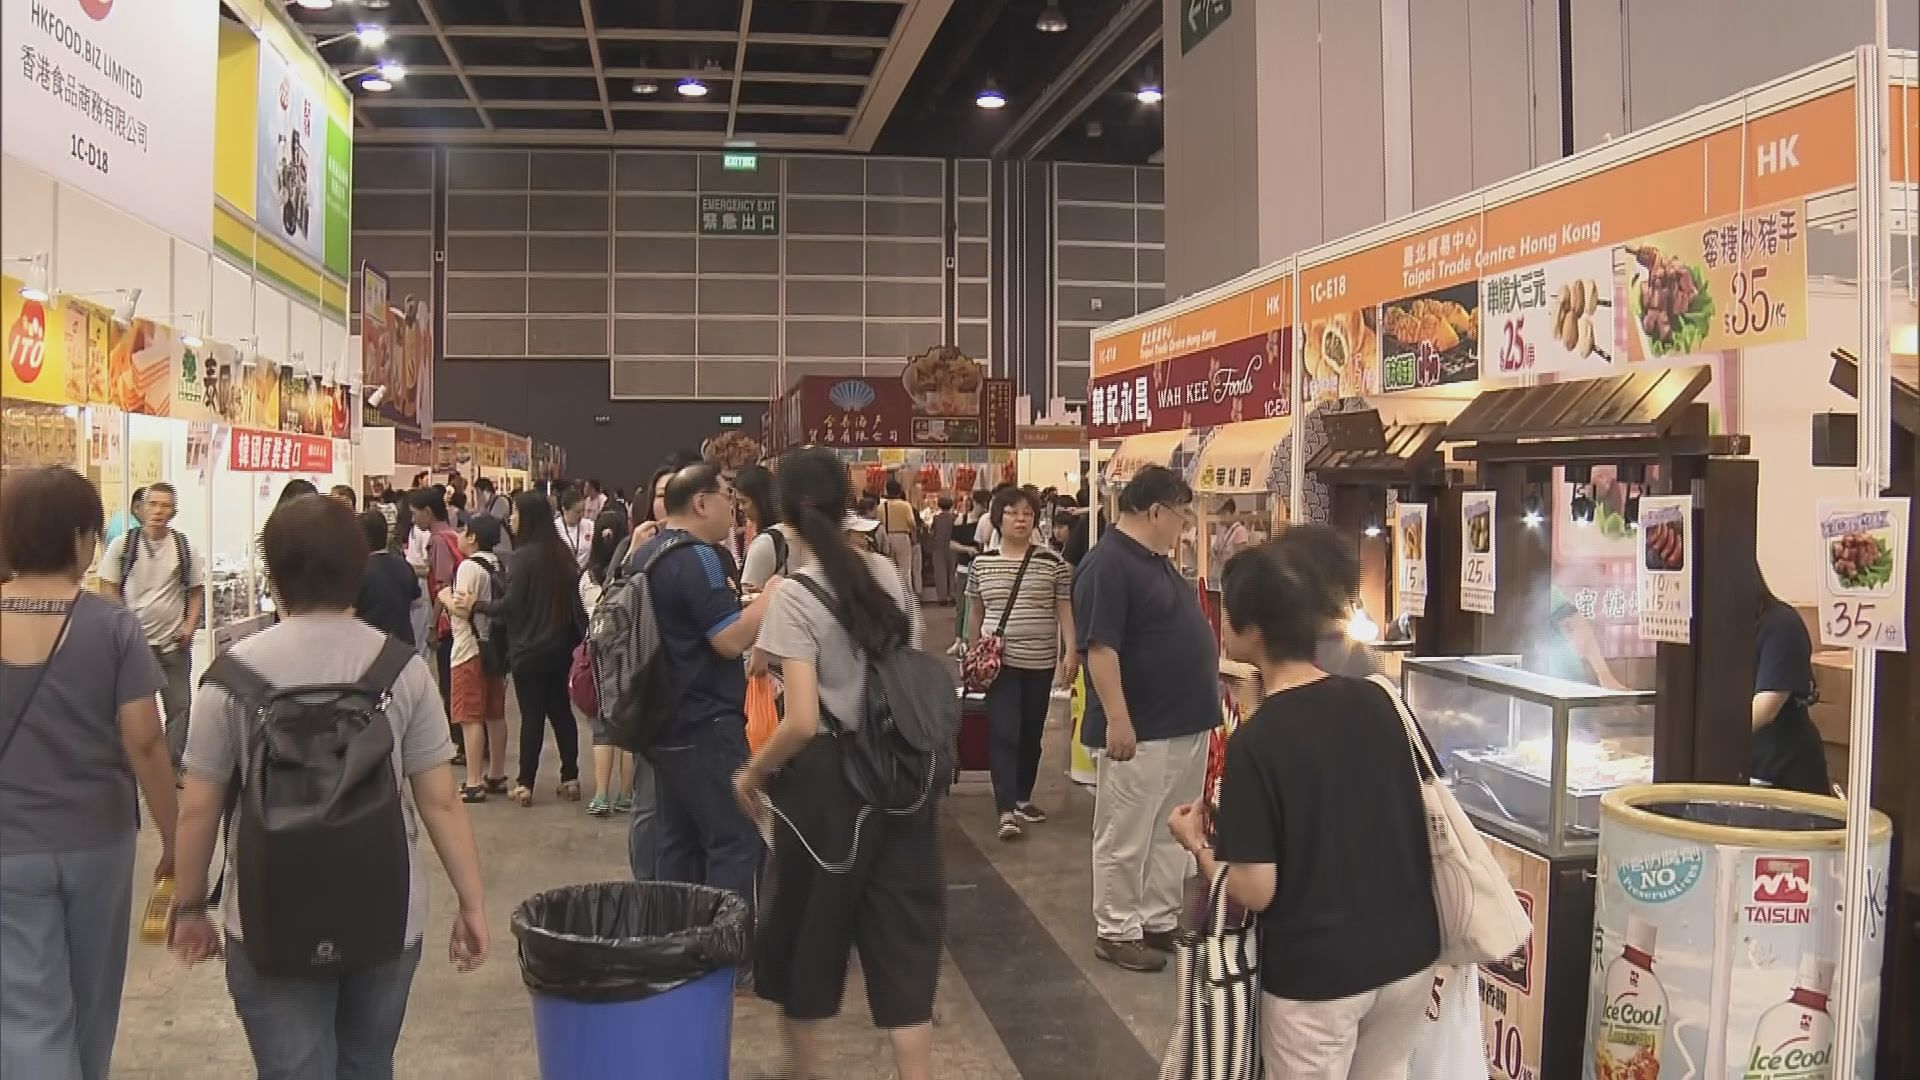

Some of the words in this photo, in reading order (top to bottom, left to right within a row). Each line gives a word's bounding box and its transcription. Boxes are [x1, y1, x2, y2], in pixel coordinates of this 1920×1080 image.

[31, 3, 102, 70] HKFOOD.BIZ
[103, 53, 143, 100] LIMITED
[21, 44, 148, 153] 香港食品商務有限公司
[71, 133, 109, 174] 1C-D18
[1757, 134, 1799, 177] HK
[757, 200, 776, 212] EXIT
[1402, 262, 1436, 288] Taipei
[1438, 250, 1472, 279] Trade
[1474, 241, 1516, 270] Centre
[1520, 231, 1558, 257] Hong
[1561, 219, 1602, 246] Kong
[1266, 296, 1281, 317] HK
[1310, 274, 1347, 305] 1C-E18
[10, 333, 44, 368] ITO
[1157, 386, 1182, 409] WAH
[1186, 379, 1210, 404] KEE
[1213, 354, 1263, 404] Foods
[1091, 376, 1148, 428] 華記永昌
[1640, 868, 1676, 890] NO
[1744, 906, 1811, 924] TAISUN
[1602, 995, 1620, 1020] Ice
[1620, 1002, 1662, 1026] Cool
[1749, 1045, 1782, 1071] Ice
[1784, 1042, 1833, 1070] Cool
